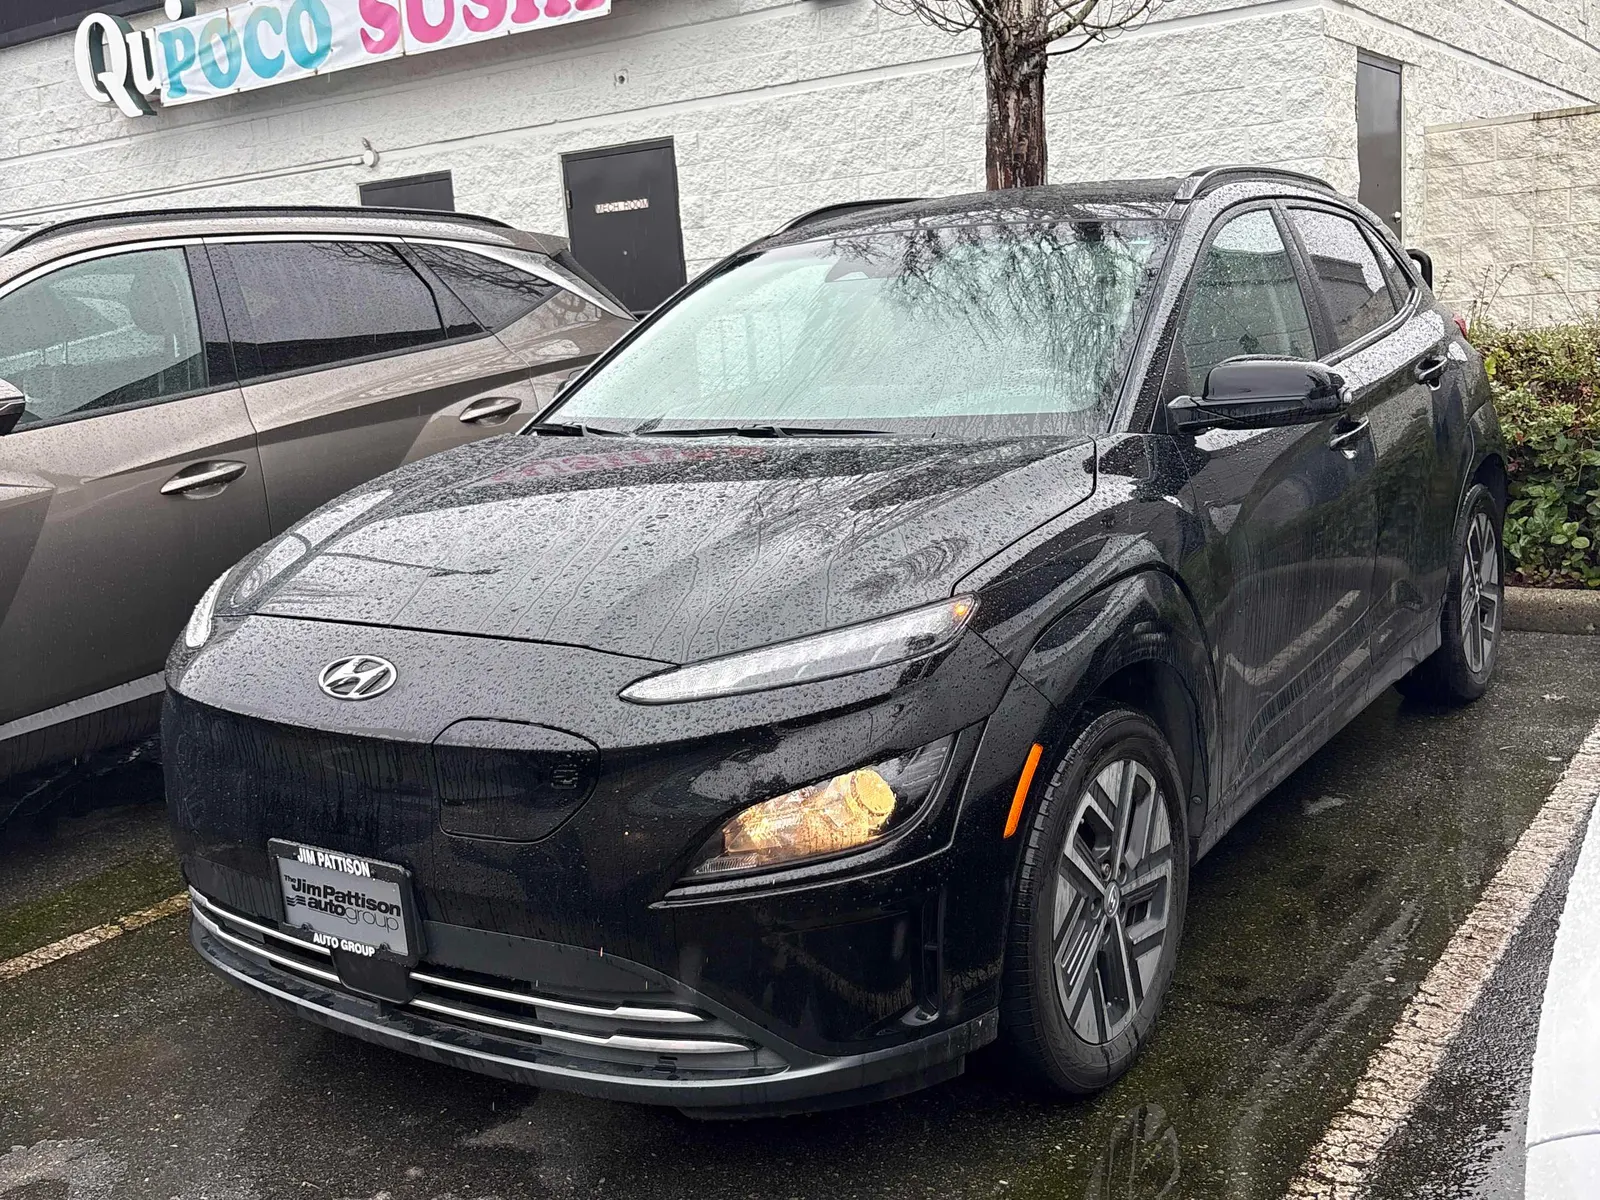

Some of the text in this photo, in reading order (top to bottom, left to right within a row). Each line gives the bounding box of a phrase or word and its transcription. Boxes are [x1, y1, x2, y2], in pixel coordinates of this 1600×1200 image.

[158, 0, 332, 98] POCO
[624, 198, 649, 211] ROOM
[297, 847, 371, 877] JIM PATTISON
[284, 874, 297, 884] The
[313, 932, 376, 957] AUTO GROUP
